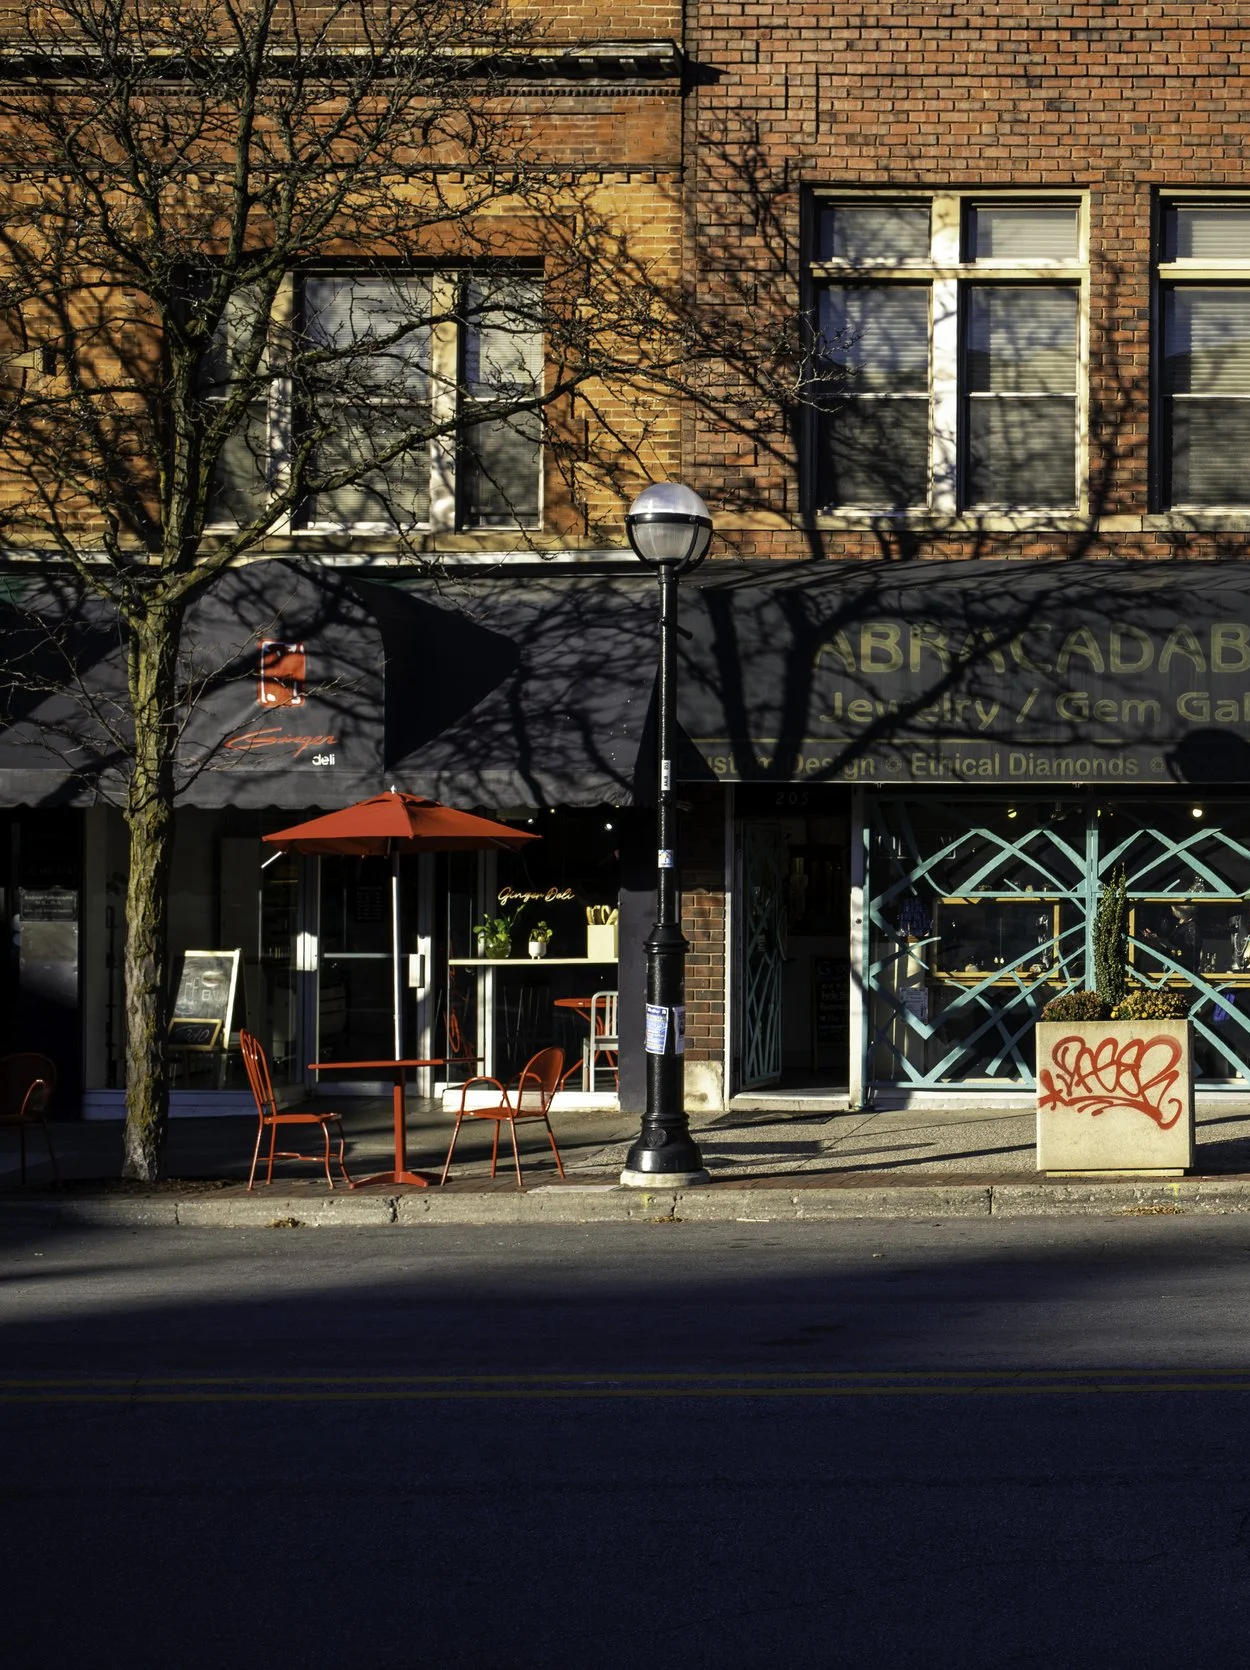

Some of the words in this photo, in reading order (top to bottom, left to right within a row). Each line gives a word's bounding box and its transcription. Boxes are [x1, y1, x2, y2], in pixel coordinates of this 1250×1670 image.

[819, 691, 1001, 730] Jewelry
[1056, 691, 1162, 723] Gem
[224, 728, 338, 758] Ginger
[312, 754, 336, 766] deli
[788, 752, 875, 780] Desgn
[911, 752, 999, 776] Ethical
[1009, 752, 1138, 776] Diamonds
[775, 791, 809, 806] 205
[497, 886, 545, 906] Ginger
[545, 886, 576, 902] Deli
